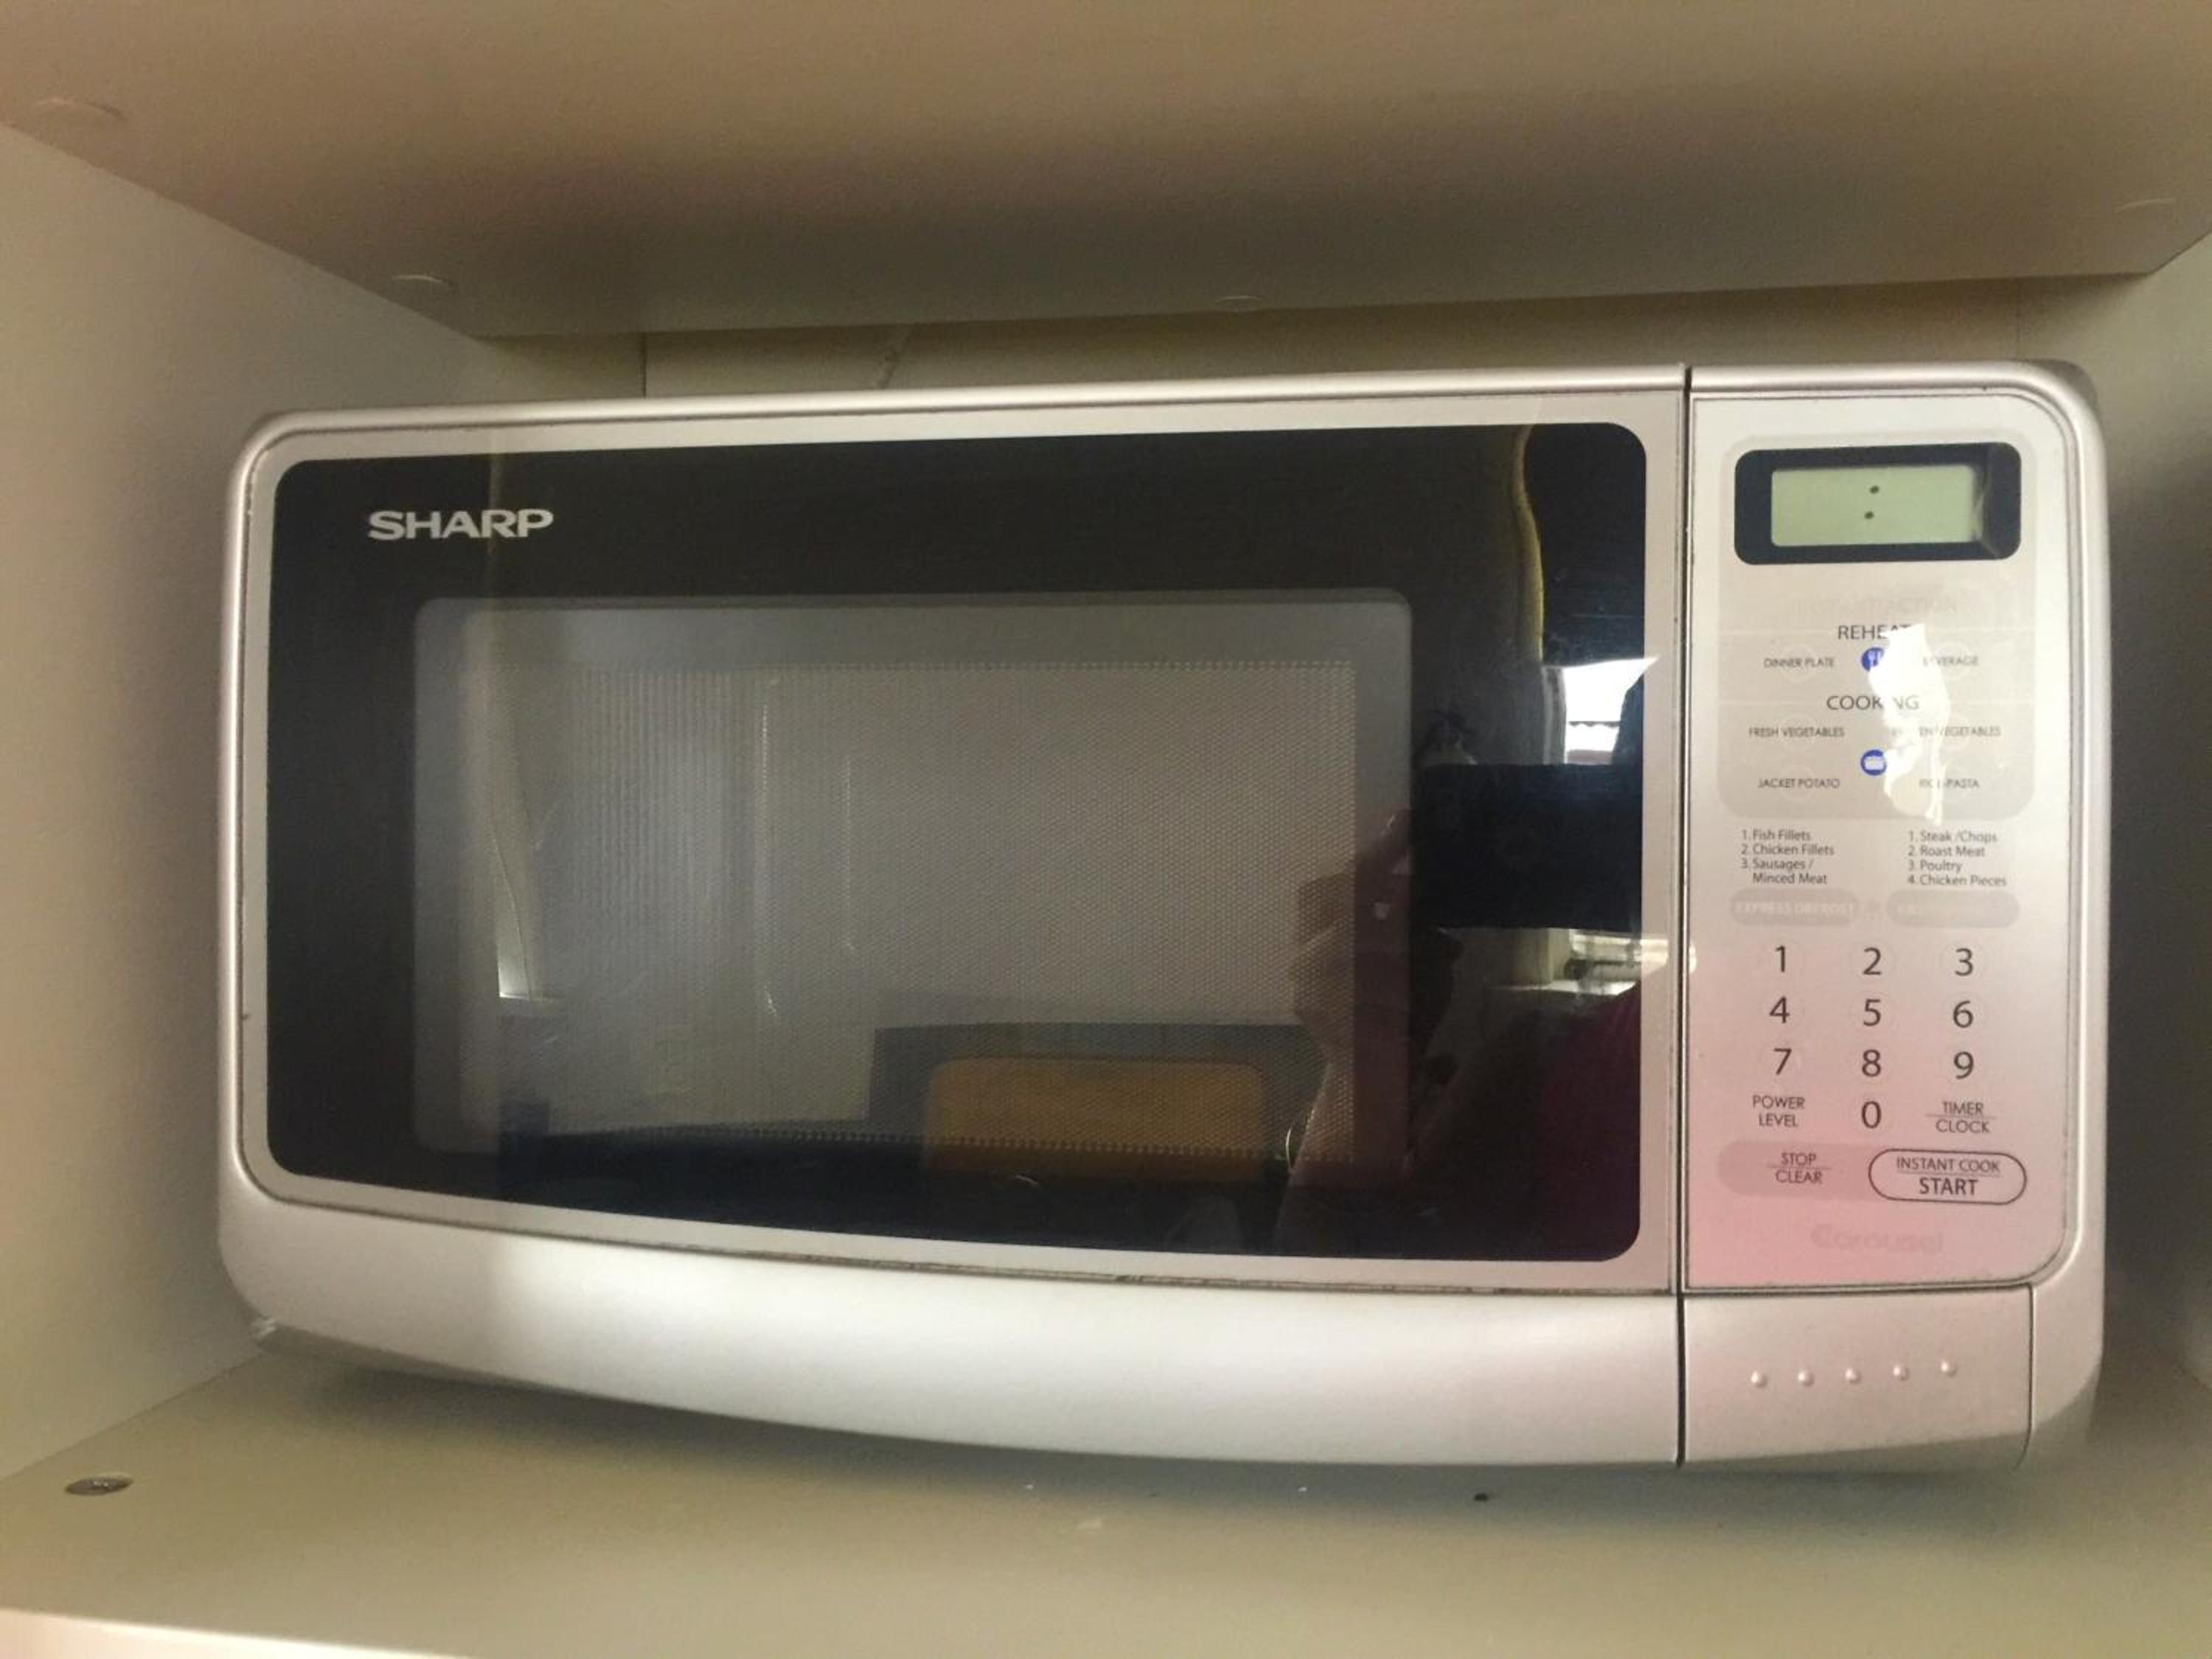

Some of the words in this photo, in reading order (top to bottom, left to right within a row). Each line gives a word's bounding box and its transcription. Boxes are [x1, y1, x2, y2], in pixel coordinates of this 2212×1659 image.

[369, 509, 554, 540] SHARP
[1838, 625, 1913, 639] REHE
[1764, 658, 1801, 667] DINNER
[1805, 657, 1834, 667] PLATE
[1826, 695, 1919, 710] COOKNG
[1749, 726, 1778, 737] FRESH
[1781, 726, 1844, 737] VEGETABLES
[1758, 778, 1795, 788] JACKET
[1798, 778, 1840, 788] POTATO
[1753, 829, 1775, 841] Fish
[1778, 830, 1811, 841] Fillets
[1920, 830, 1952, 841] Steak
[1753, 844, 1798, 855] Chicken
[1802, 844, 1834, 855] Fillets
[1920, 846, 1952, 856] Roast
[1956, 846, 1986, 857] Meat
[1753, 858, 1806, 871] Sausages
[1920, 860, 1962, 874] Poultry
[1753, 872, 1795, 884] Minced
[1798, 872, 1828, 885] Meat
[1919, 874, 1967, 886] Chicken
[1970, 874, 2007, 886] Pieces
[1775, 946, 1786, 972] 1
[1863, 948, 1882, 975] 2
[1955, 949, 1974, 975] 3
[1770, 997, 1790, 1023] 4
[1863, 999, 1881, 1026] 5
[1953, 1001, 1974, 1028] 6
[1774, 1048, 1792, 1074] 7
[1862, 1050, 1882, 1077] 8
[1954, 1052, 1974, 1079] 9
[1753, 1095, 1805, 1109] POWER
[1942, 1102, 1983, 1115] TIMER
[1759, 1113, 1798, 1127] LEVEL
[1862, 1101, 1882, 1128] 0
[1936, 1119, 1990, 1133] CLOCK
[1781, 1152, 1816, 1166] STOP
[1897, 1156, 1954, 1171] INSTANT
[1959, 1158, 2000, 1172] COOK
[1775, 1169, 1822, 1184] CLEAR
[1919, 1177, 1978, 1196] START
